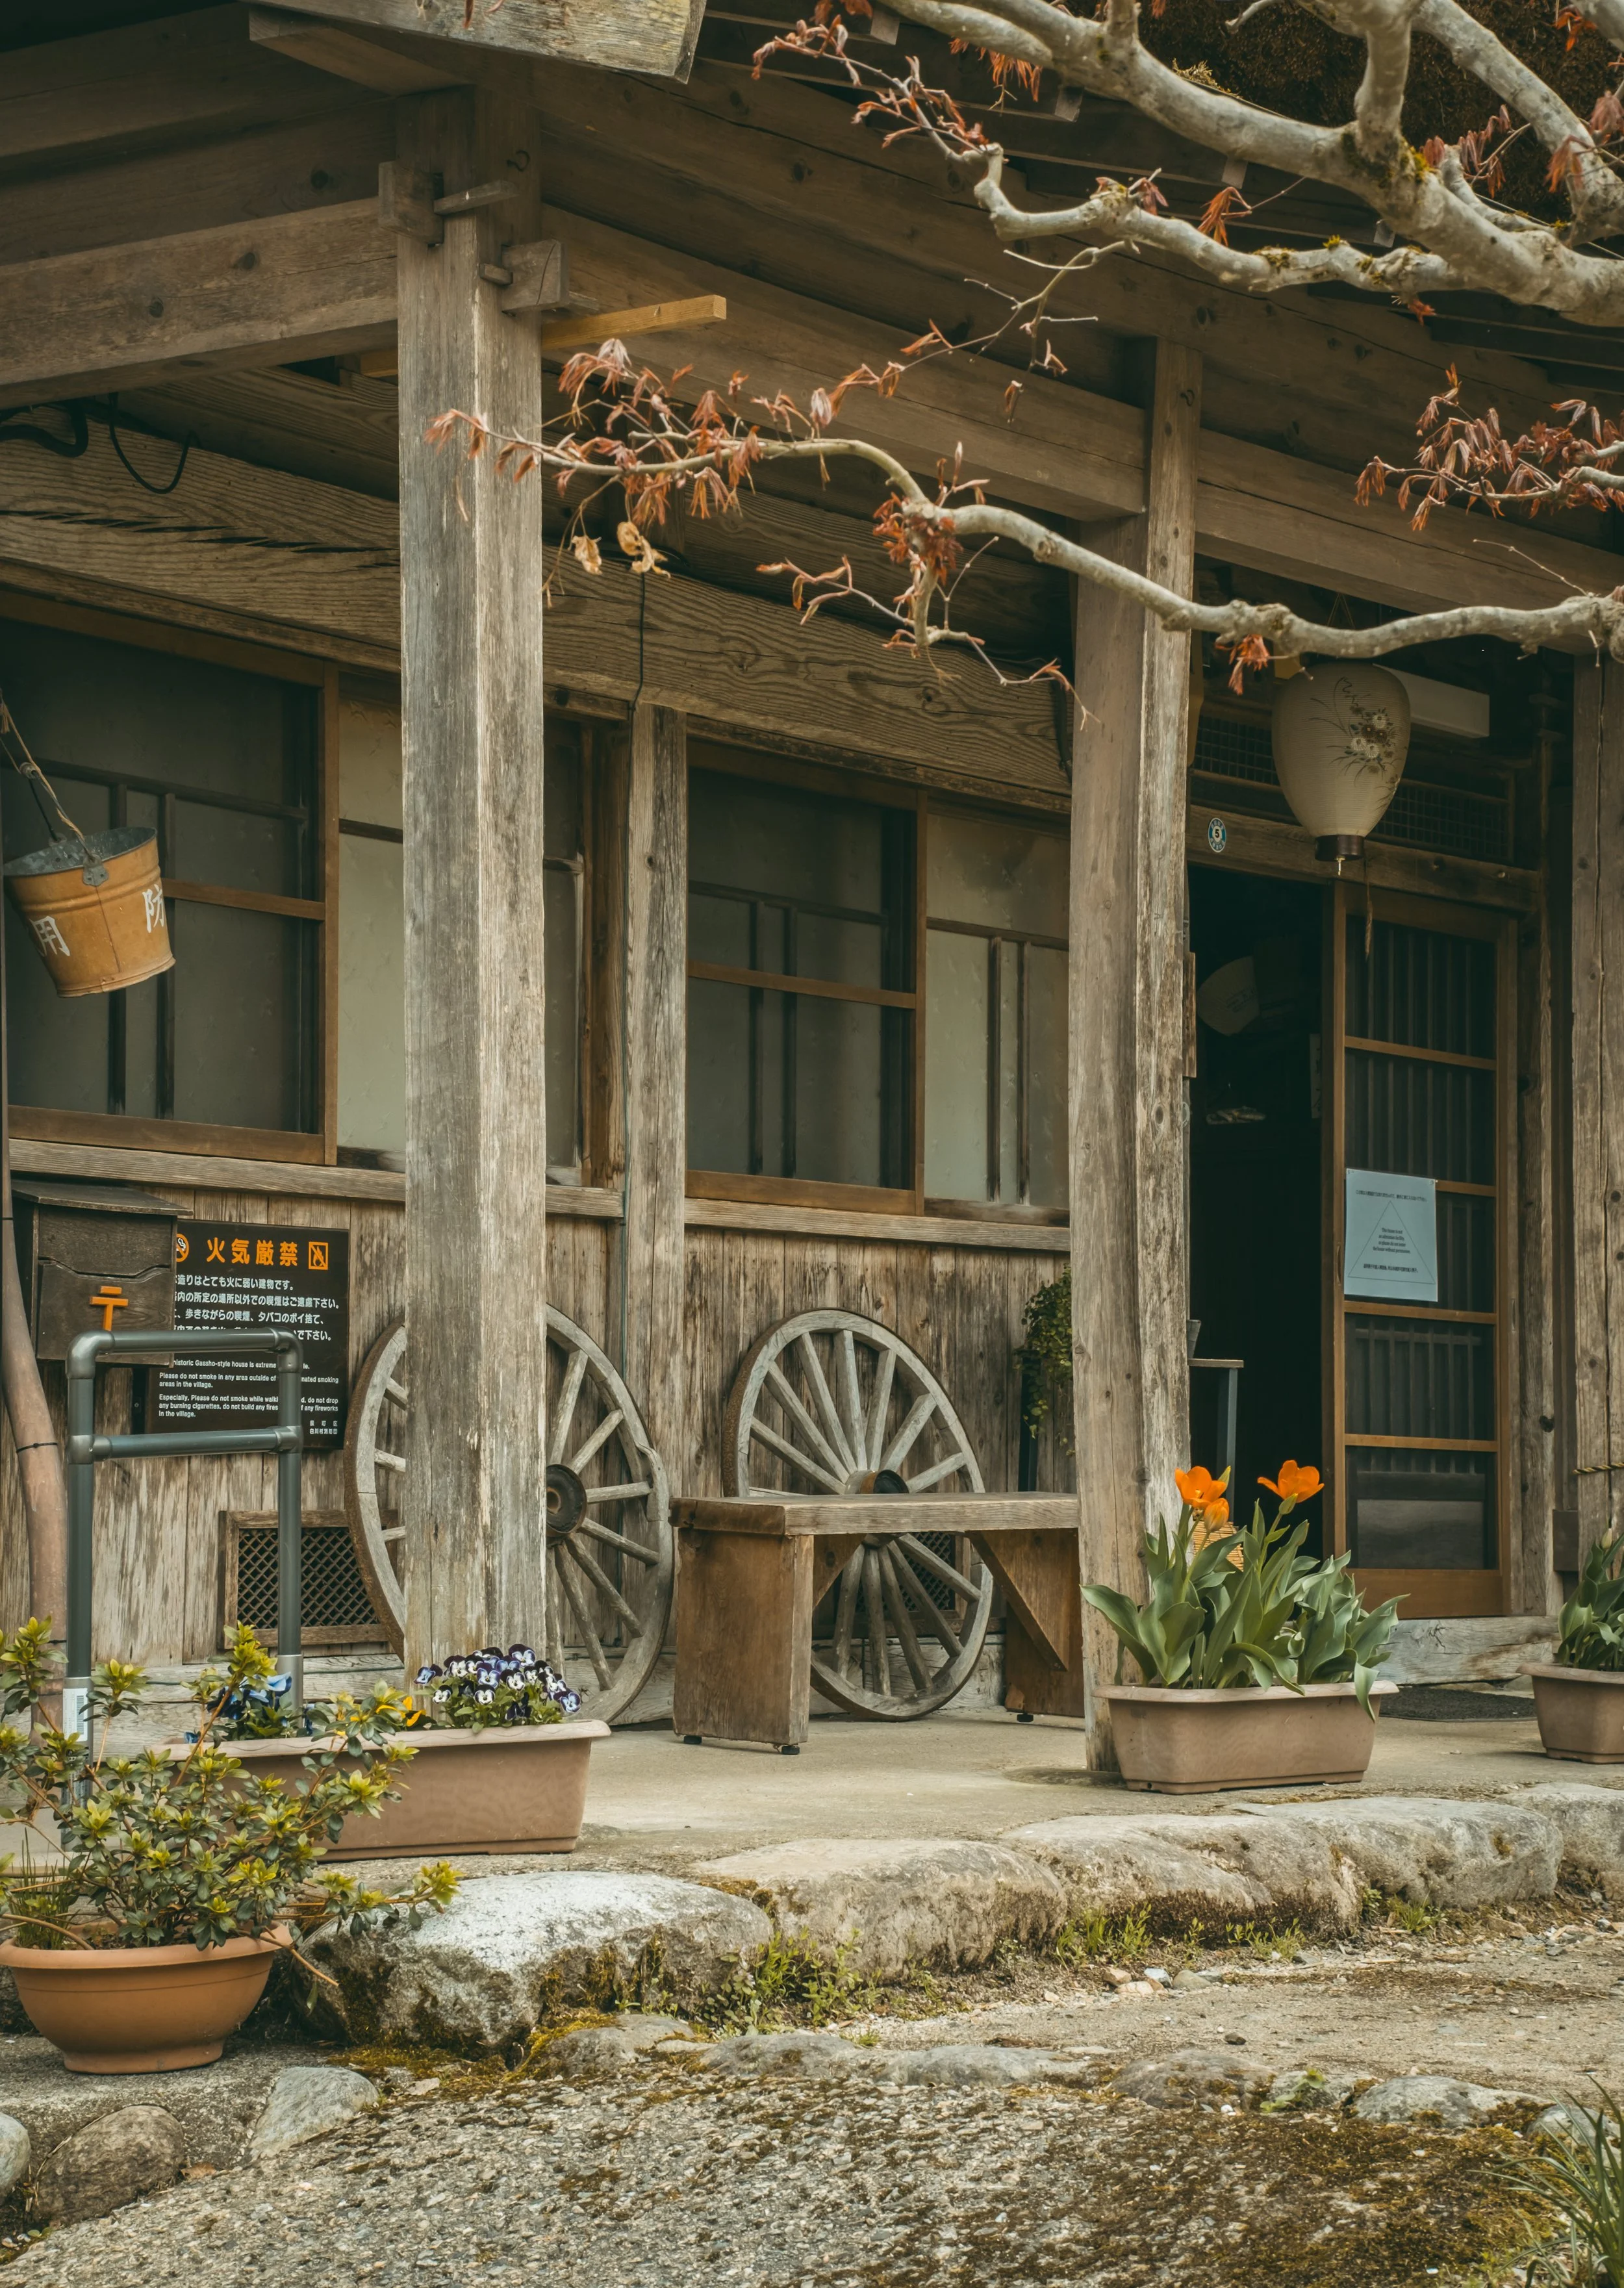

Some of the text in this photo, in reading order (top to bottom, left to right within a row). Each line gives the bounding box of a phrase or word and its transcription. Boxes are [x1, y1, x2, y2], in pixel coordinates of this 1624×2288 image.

[1215, 828, 1220, 838] 5
[30, 915, 70, 957] 用
[206, 1237, 298, 1267] 火気厳禁
[175, 1275, 294, 1291] 造りはとても火に弱い建物です。
[175, 1291, 339, 1309] 内の所定の場所以外での喫煙はご遠慮下さい。
[294, 1330, 331, 1341] で下さい。
[195, 1360, 231, 1368] Gassho-style
